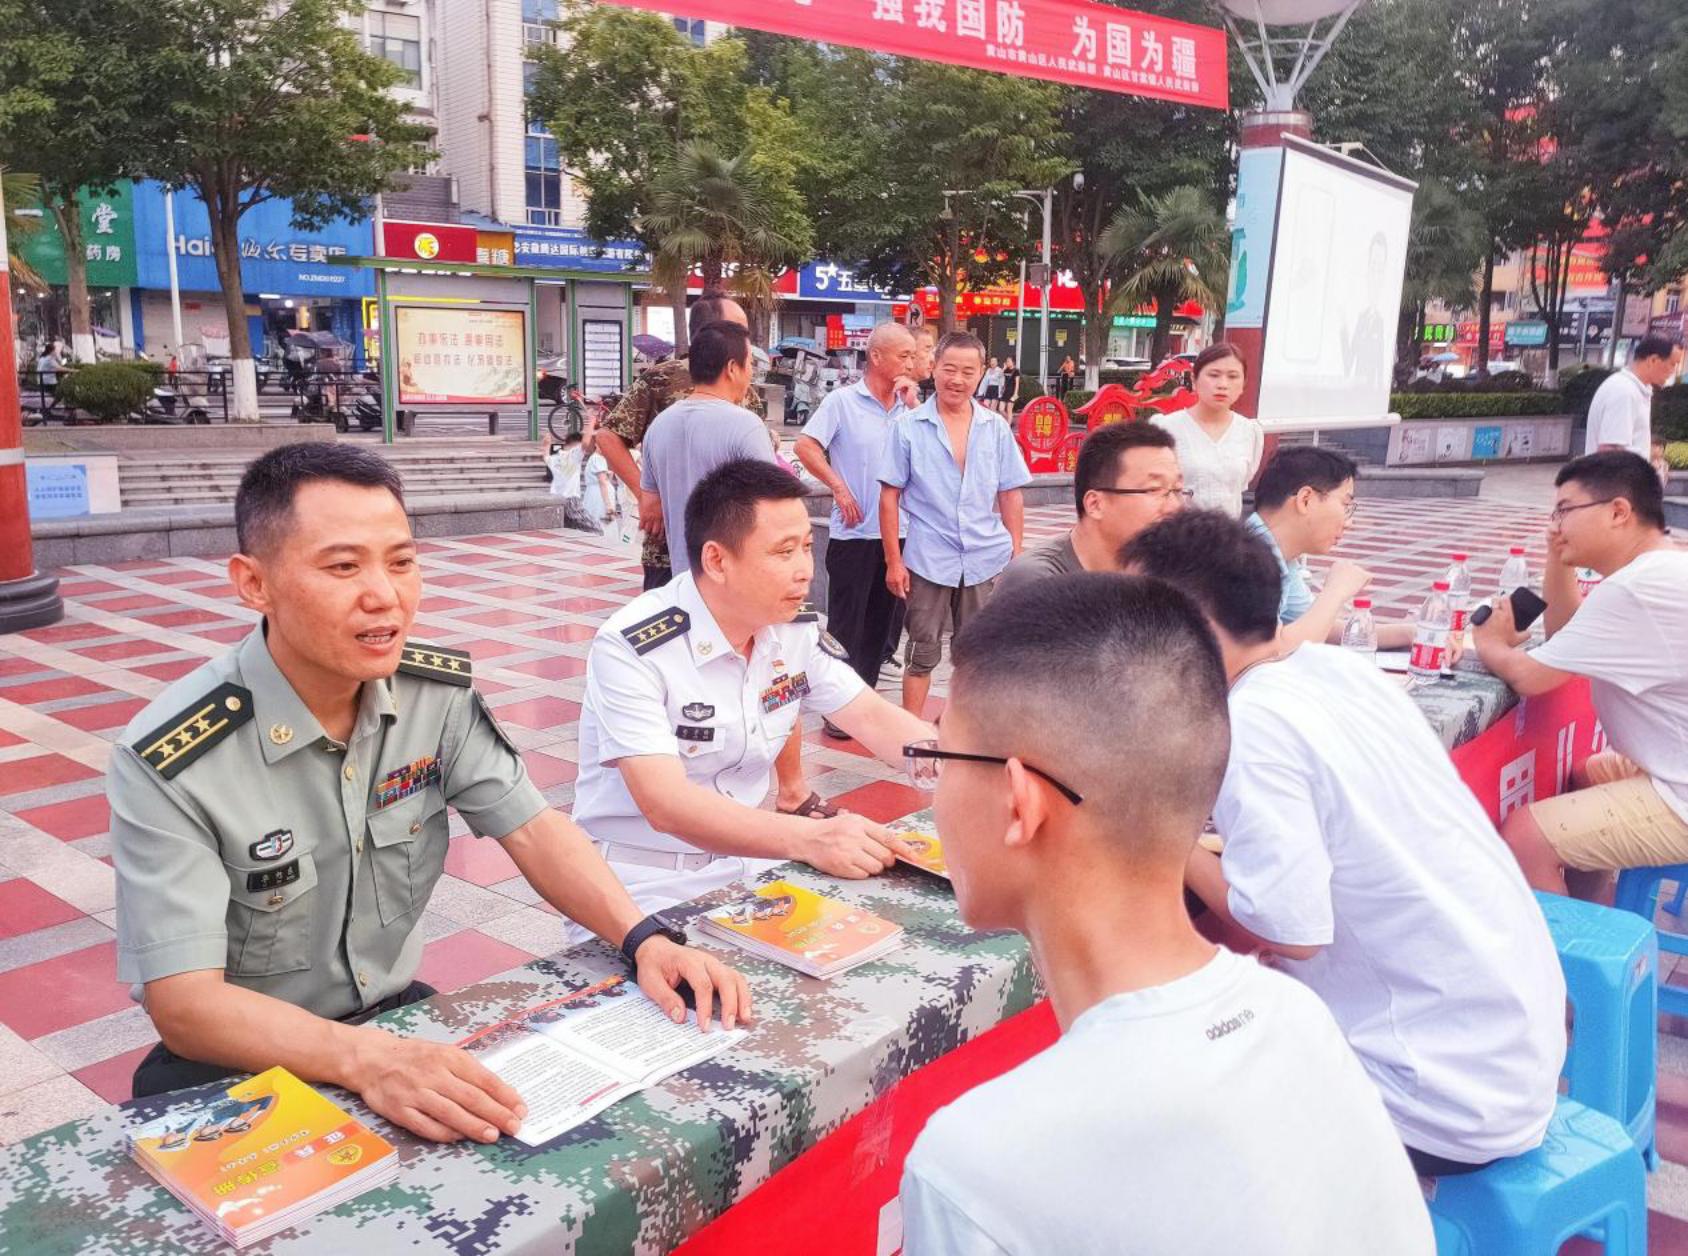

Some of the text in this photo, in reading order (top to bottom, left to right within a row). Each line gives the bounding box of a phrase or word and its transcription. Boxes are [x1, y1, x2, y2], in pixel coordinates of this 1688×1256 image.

[1072, 15, 1197, 80] 为国为疆
[91, 202, 118, 234] 堂
[86, 244, 121, 262] 药房
